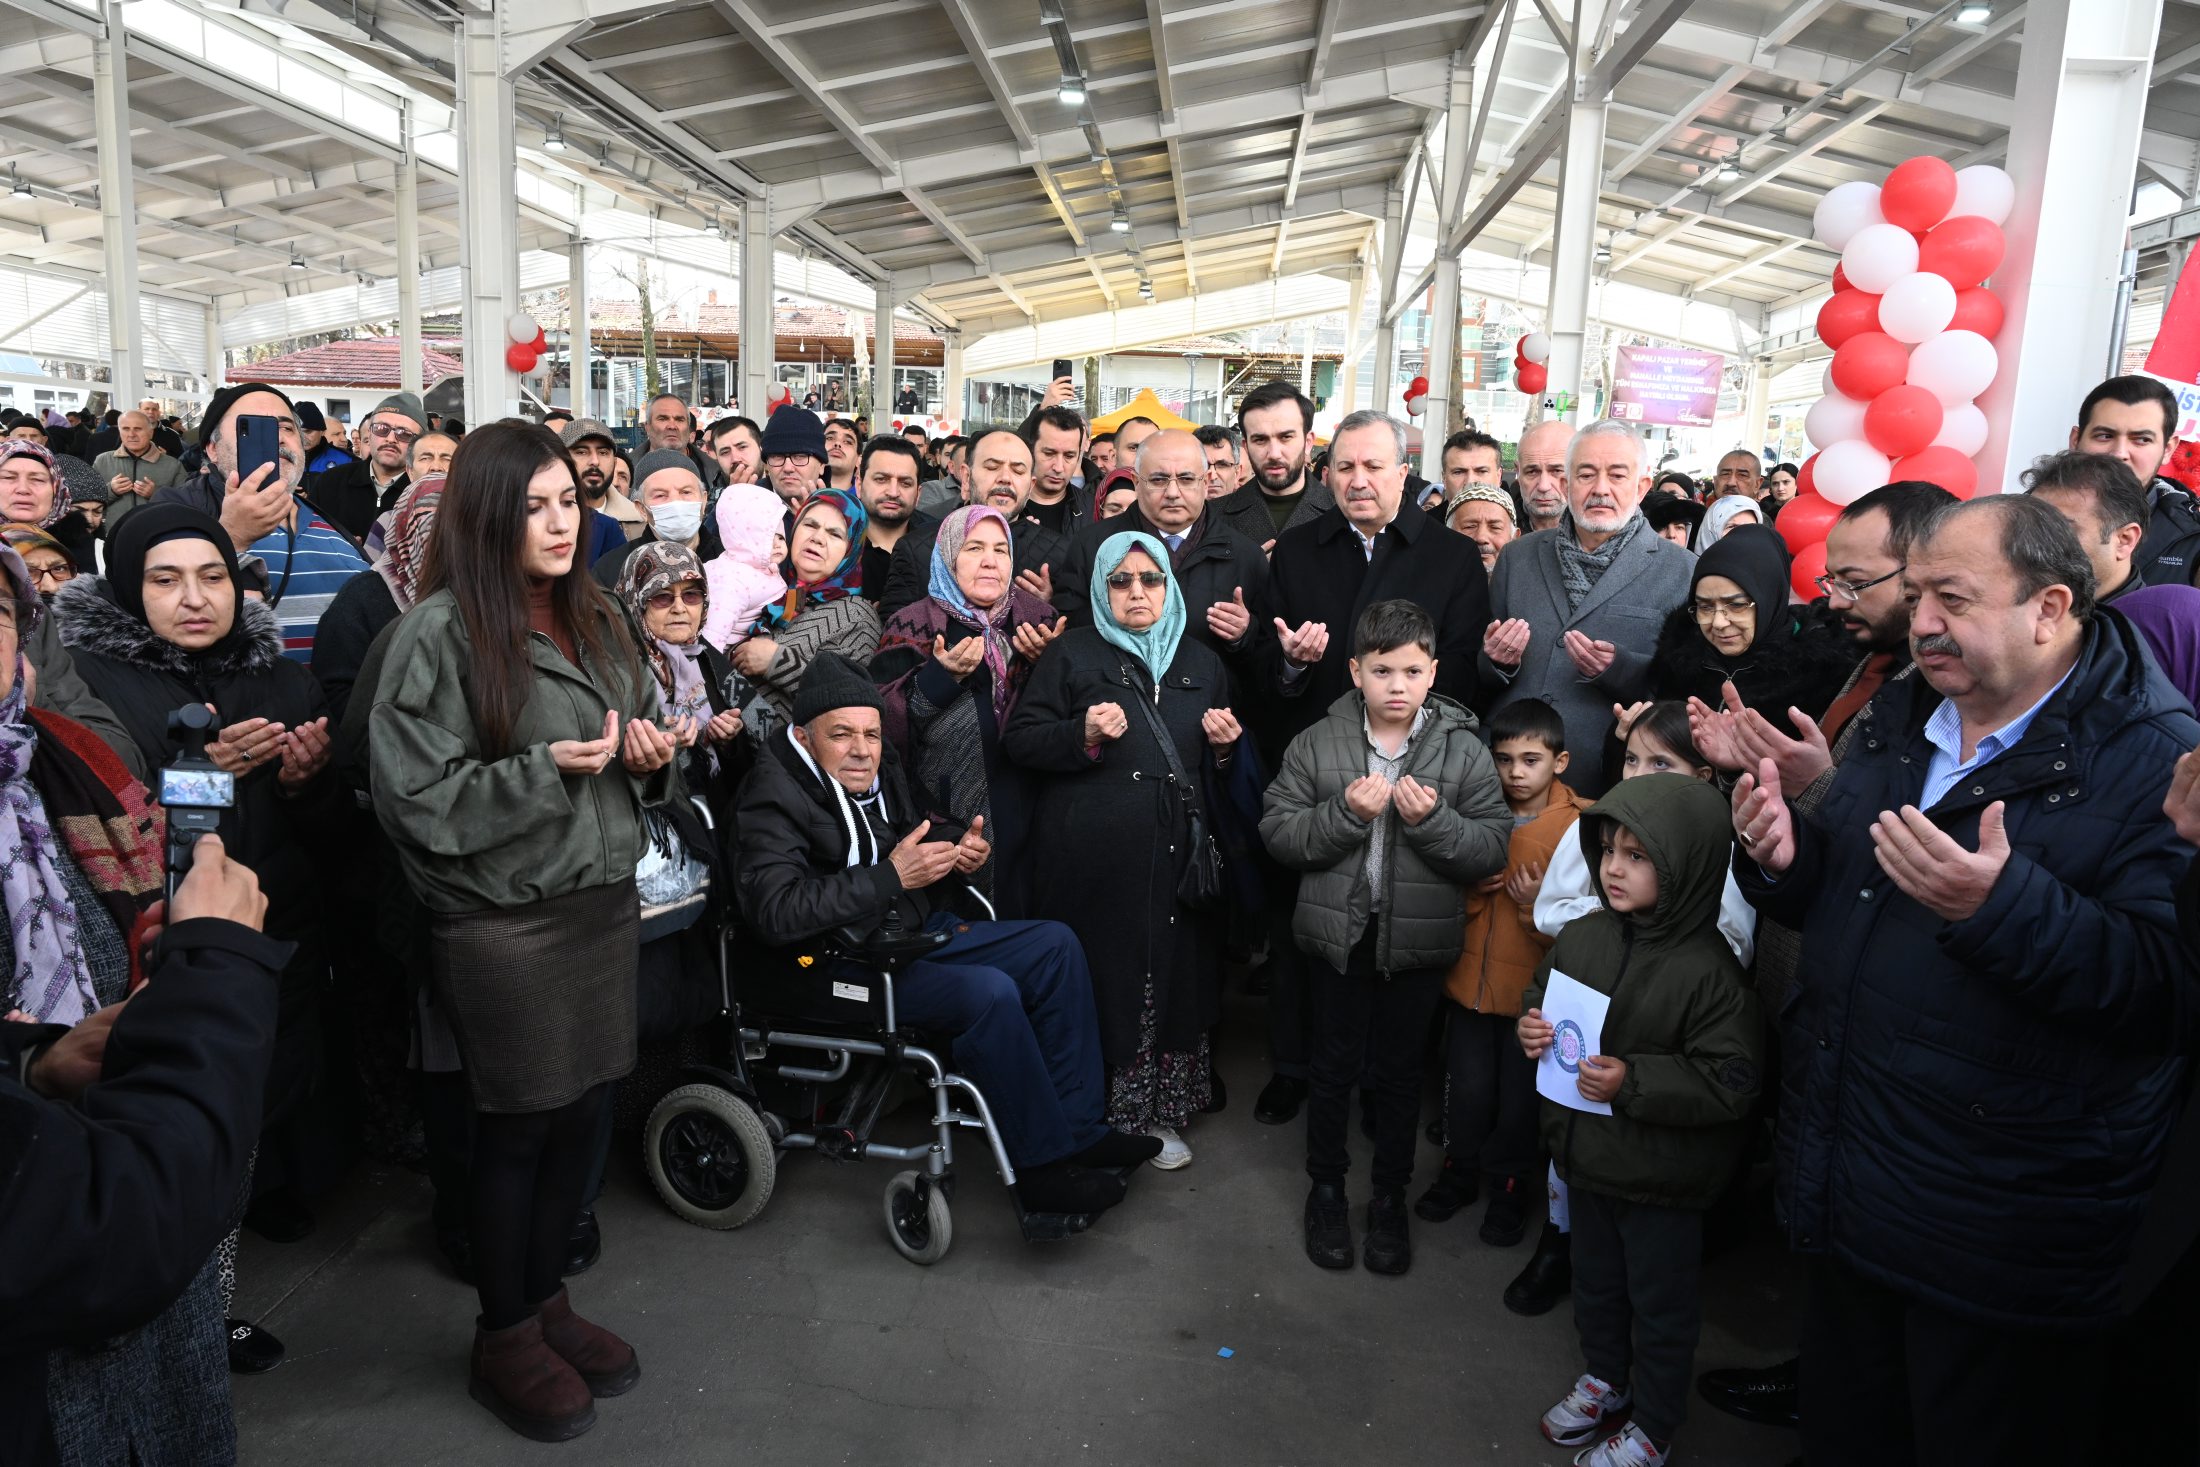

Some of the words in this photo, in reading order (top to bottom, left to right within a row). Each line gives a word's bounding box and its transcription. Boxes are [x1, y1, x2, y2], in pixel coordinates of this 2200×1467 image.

[1631, 354, 1657, 363] KAPALI
[1657, 356, 1680, 365] PAZAR
[1615, 378, 1631, 387] TÜM
[1671, 384, 1681, 392] VE
[1585, 1382, 1602, 1395] NIKE
[1641, 1442, 1658, 1458] NIKE
